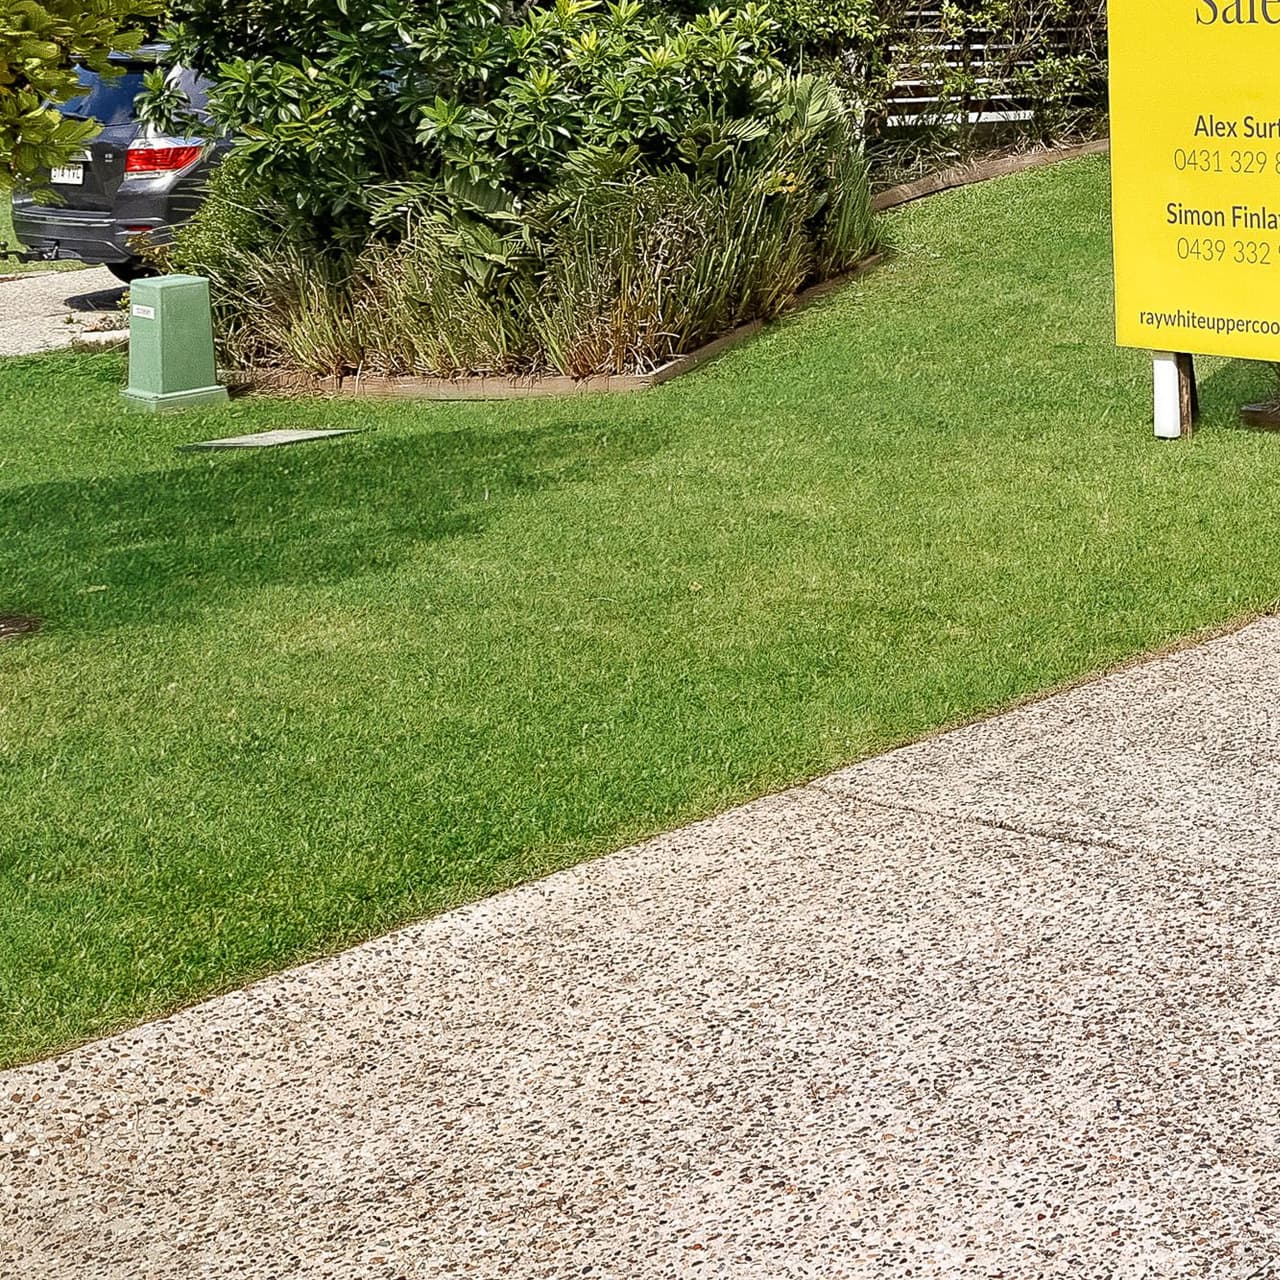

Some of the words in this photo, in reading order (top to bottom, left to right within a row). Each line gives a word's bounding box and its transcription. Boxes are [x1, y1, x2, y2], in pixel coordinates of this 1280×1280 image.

[1193, 114, 1238, 138] Alex
[1174, 148, 1223, 173] 0431
[1230, 150, 1267, 174] 329
[1166, 202, 1225, 228] Simon
[1177, 237, 1226, 262] 0439
[1233, 240, 1271, 265] 332
